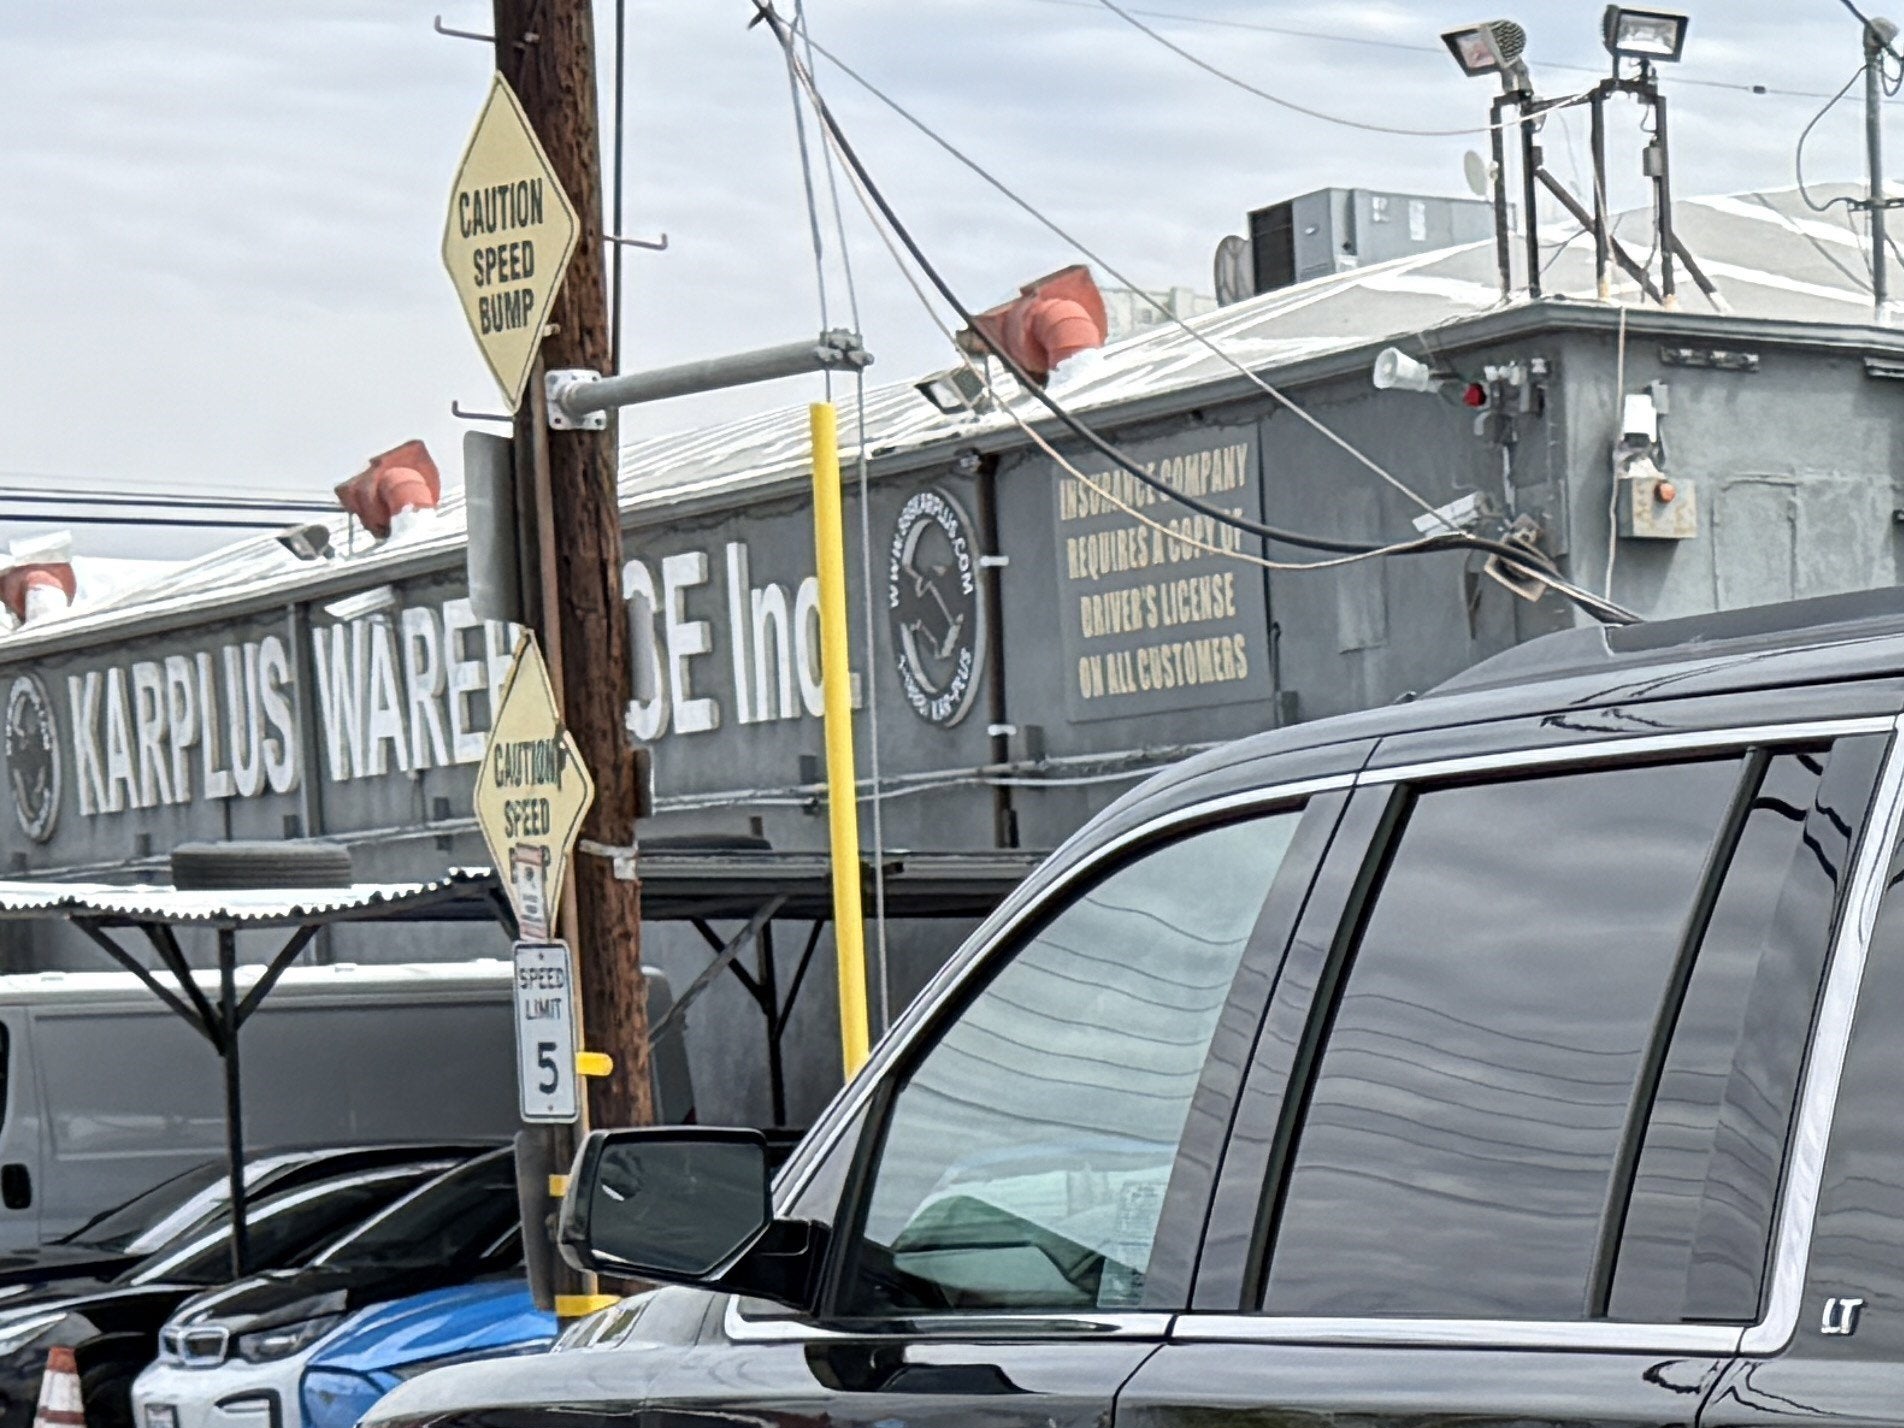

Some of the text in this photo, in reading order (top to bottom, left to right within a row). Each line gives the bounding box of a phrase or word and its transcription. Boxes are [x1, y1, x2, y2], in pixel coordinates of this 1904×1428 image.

[459, 177, 543, 239] CAUTION
[473, 240, 535, 287] SPEED
[479, 288, 535, 335] BUMP
[1059, 443, 1248, 521] INSURANCE COMPANY
[1067, 524, 1149, 581] REQUIRES
[1152, 524, 1164, 565] A
[1168, 514, 1217, 563] COPY
[1080, 572, 1236, 638] DRIVER'S LICENSE
[1078, 633, 1248, 699] ON ALL CUSTOMERS
[68, 635, 301, 817] KARPLUS
[494, 738, 561, 788] CAUTION
[504, 798, 550, 838] SPEED
[519, 967, 564, 990] SPEED
[525, 998, 562, 1020] LIMIT
[538, 1041, 559, 1095] 5
[1820, 1297, 1864, 1335] LT
